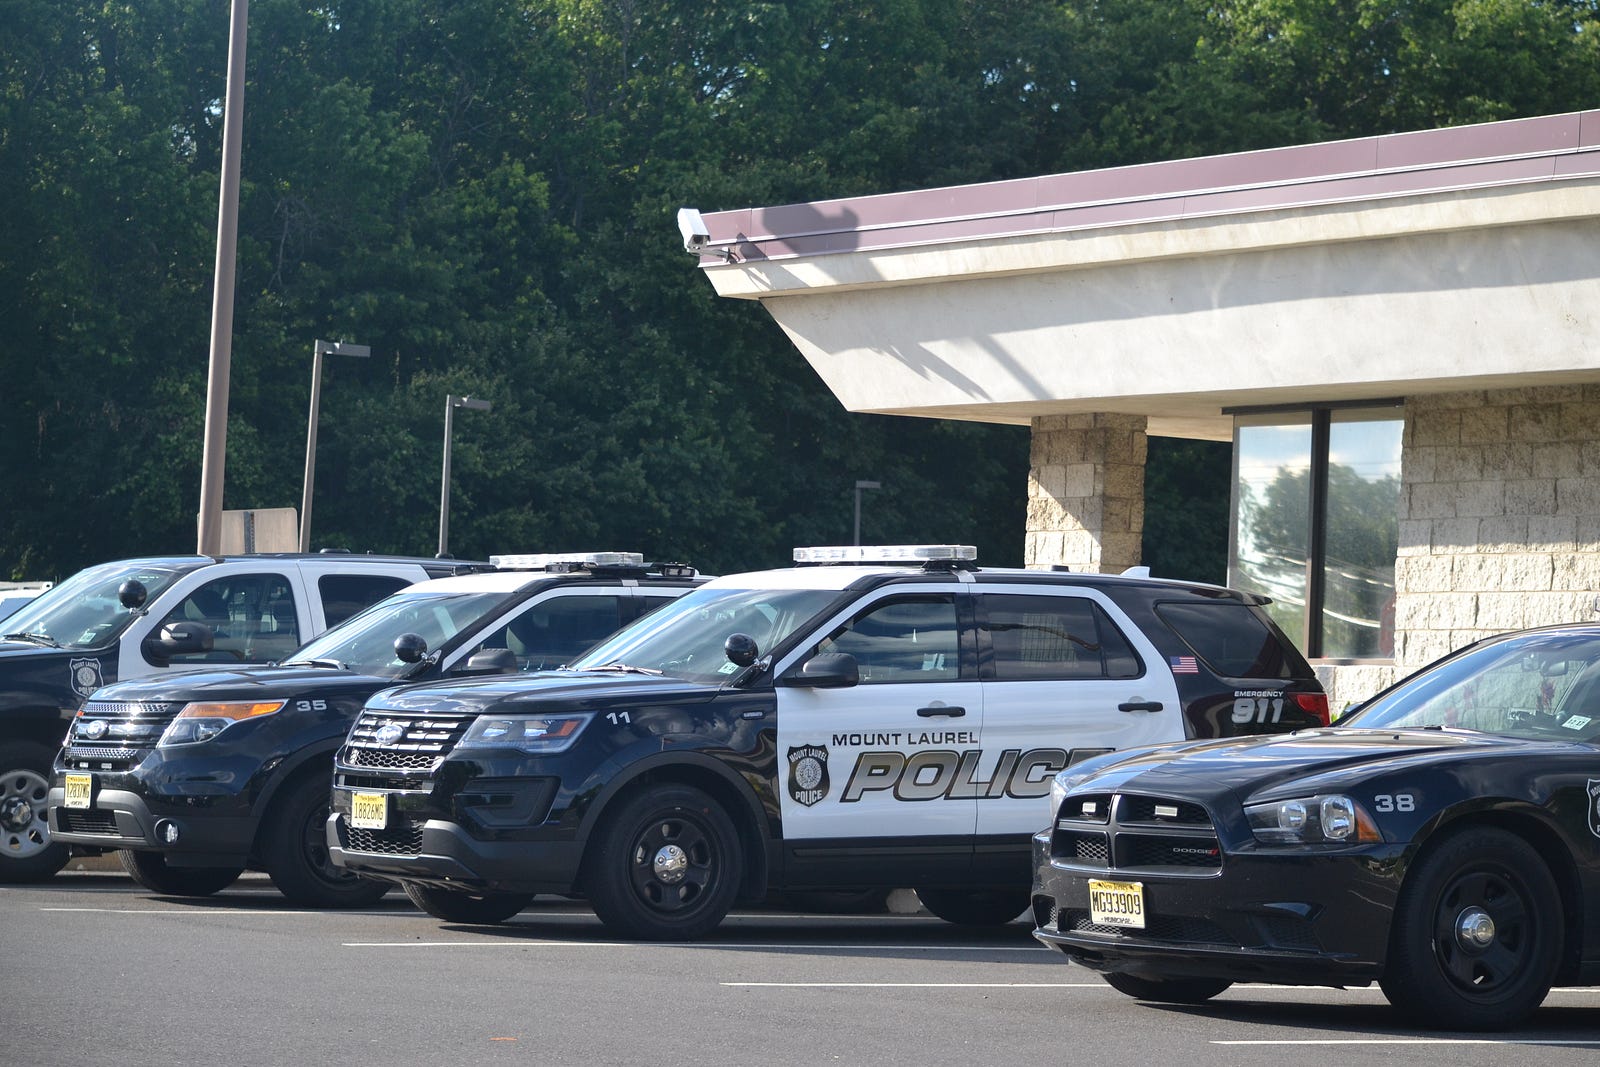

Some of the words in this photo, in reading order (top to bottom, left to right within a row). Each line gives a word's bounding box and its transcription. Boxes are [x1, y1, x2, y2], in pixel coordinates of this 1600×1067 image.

[296, 699, 327, 712] 35
[1231, 698, 1284, 723] 911
[606, 711, 631, 725] 11
[832, 733, 901, 746] MOUNT
[907, 731, 978, 745] LAUREL
[789, 748, 807, 763] MOUNT
[808, 748, 828, 762] LAUREL
[838, 747, 1116, 802] POLIC
[795, 789, 822, 805] POLICE
[1374, 794, 1415, 812] 38
[354, 802, 384, 821] 18826MG
[1172, 847, 1213, 855] DODGE
[1092, 891, 1141, 915] MG93909
